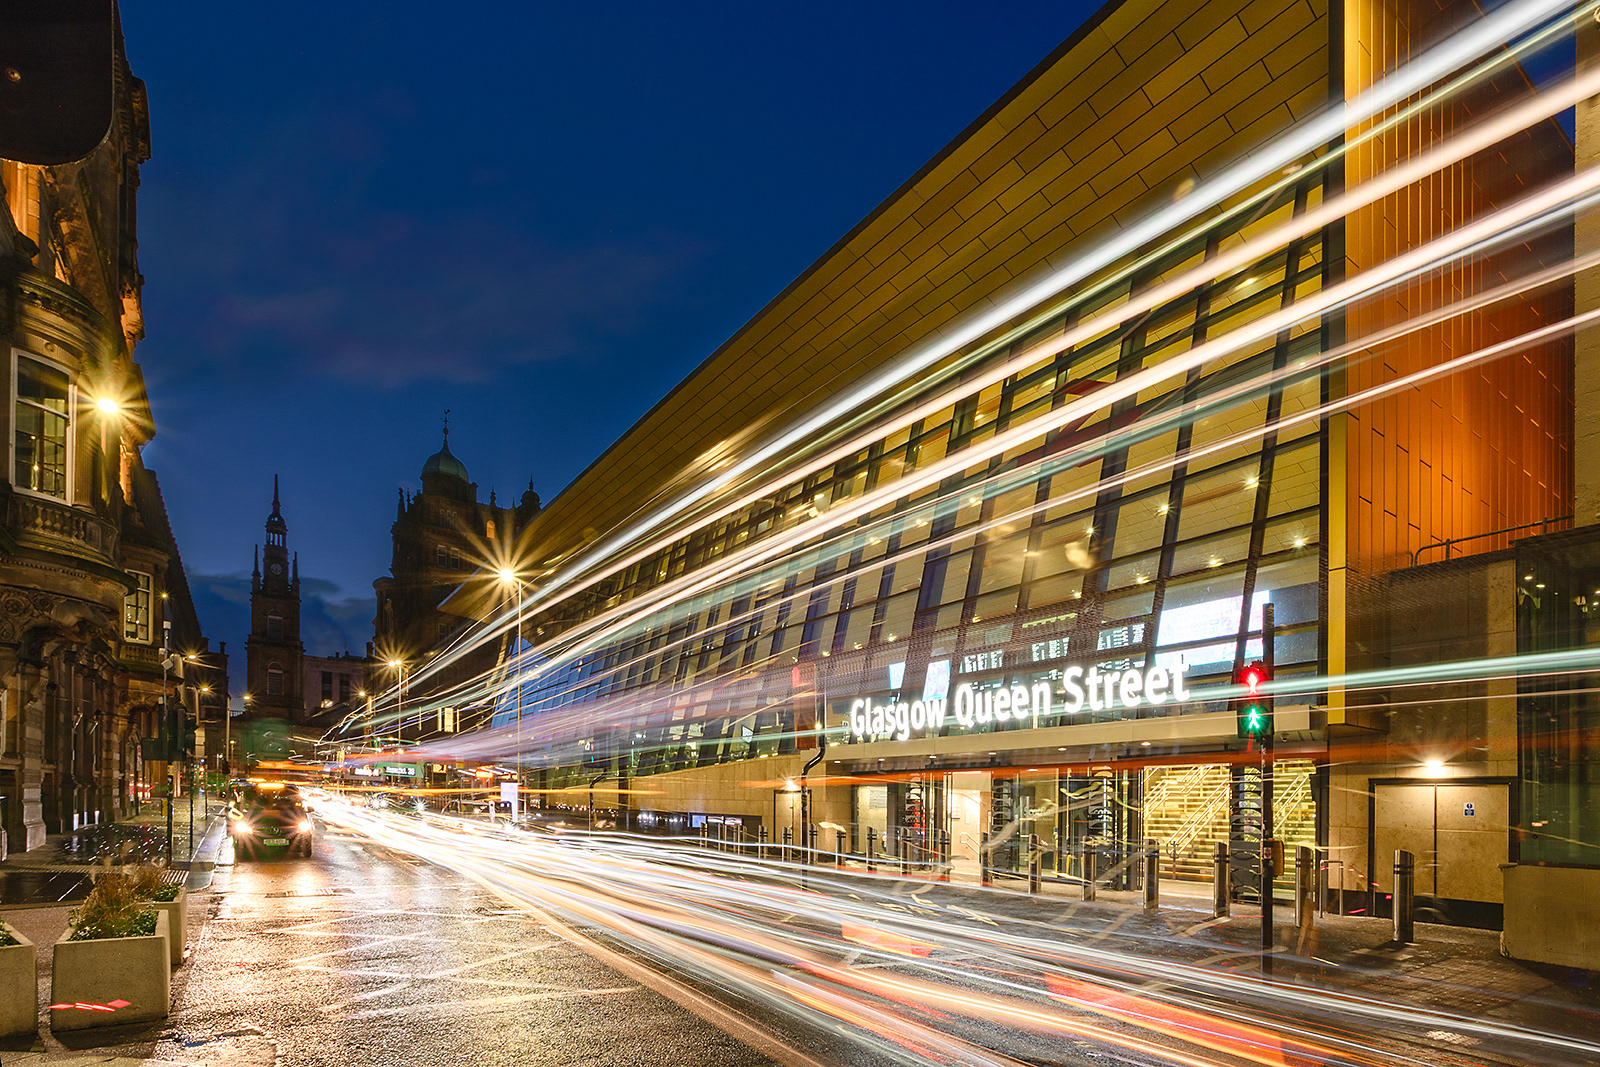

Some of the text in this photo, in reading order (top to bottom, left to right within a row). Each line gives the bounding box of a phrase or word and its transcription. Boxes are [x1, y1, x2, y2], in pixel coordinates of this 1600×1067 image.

[850, 653, 1192, 741] Glasgow Queen Street
